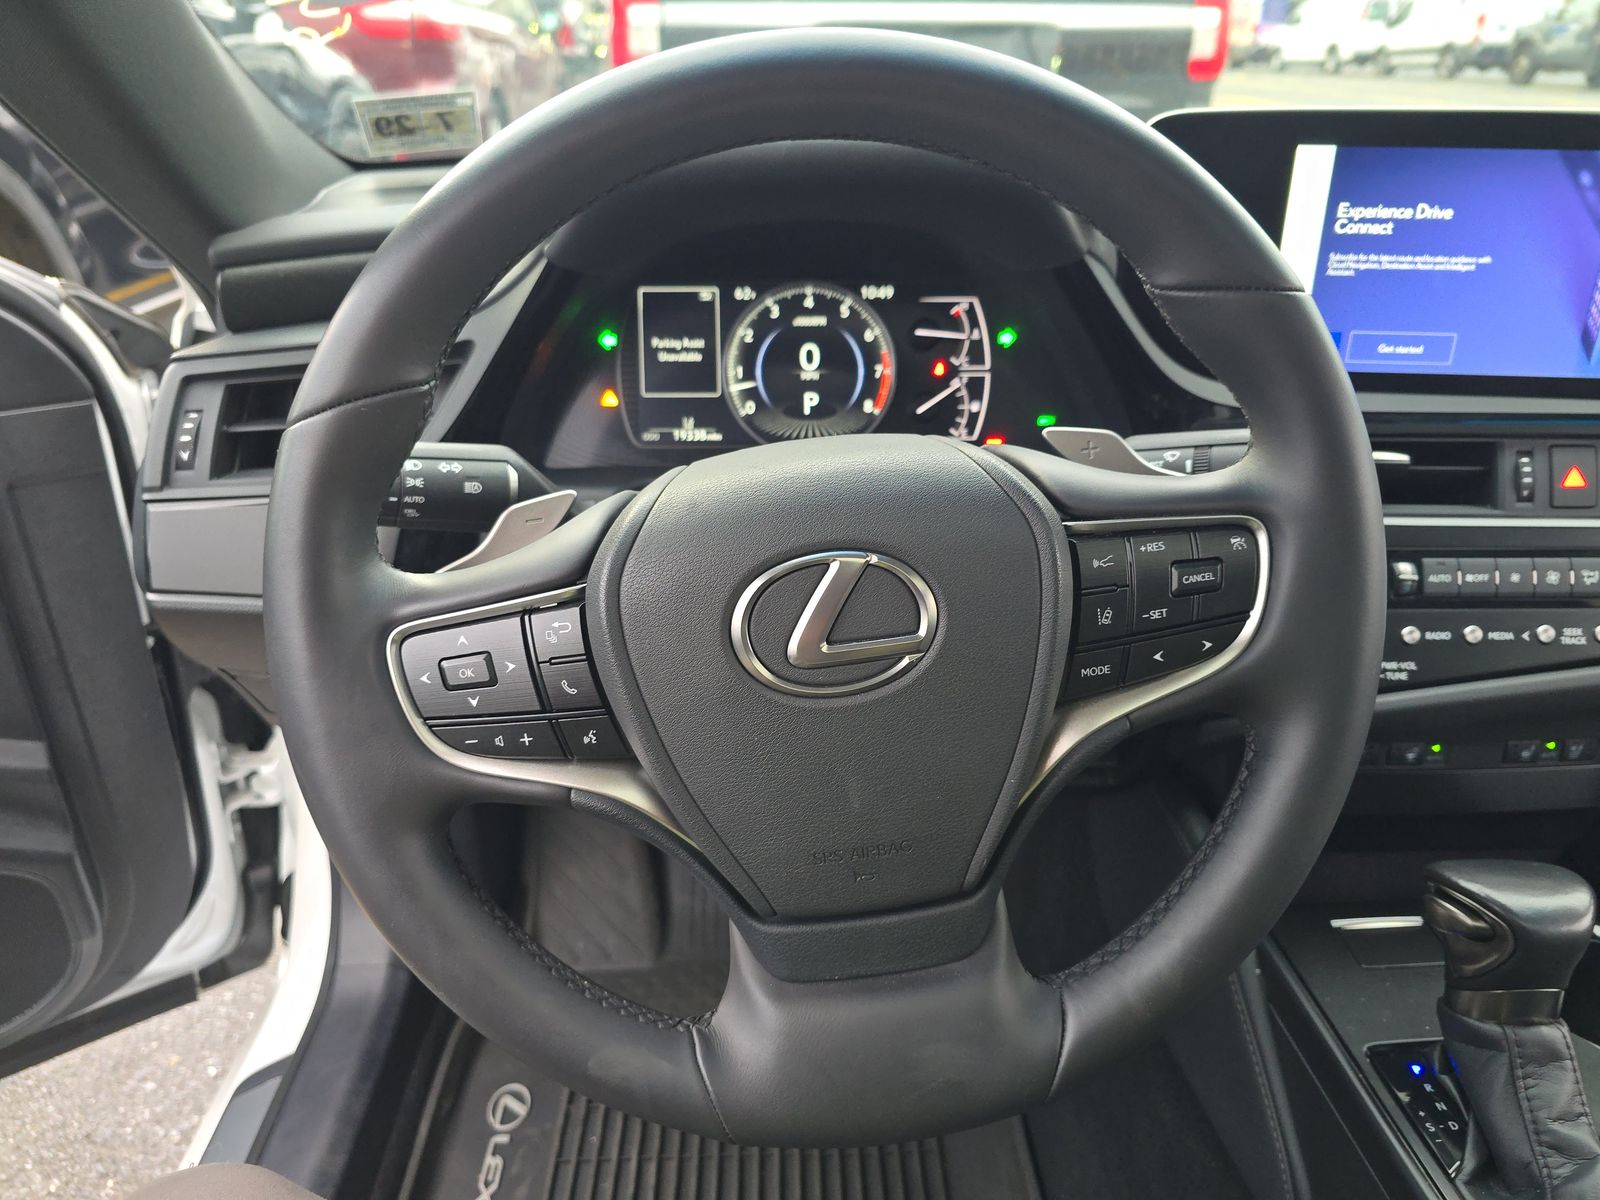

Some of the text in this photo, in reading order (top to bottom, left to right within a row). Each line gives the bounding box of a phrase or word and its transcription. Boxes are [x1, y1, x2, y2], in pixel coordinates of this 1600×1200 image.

[1336, 202, 1455, 221] Experience Drive
[1334, 219, 1395, 235] Connect
[1377, 343, 1394, 354] Get
[798, 342, 821, 372] 0
[803, 391, 820, 416] P
[404, 496, 425, 504] AUTO
[1182, 572, 1215, 584] CANCEL
[1427, 573, 1452, 583] AUTO
[1424, 630, 1452, 641] RADIO
[1488, 630, 1515, 641] MEDIA
[1562, 627, 1584, 636] SEEK
[1560, 636, 1587, 645] TRACK
[459, 667, 474, 679] OK
[1081, 664, 1111, 678] MODE
[813, 840, 913, 866] SRS AIRBAG
[1423, 1083, 1435, 1093] R
[1435, 1101, 1448, 1111] N
[1425, 1121, 1459, 1132] S D
